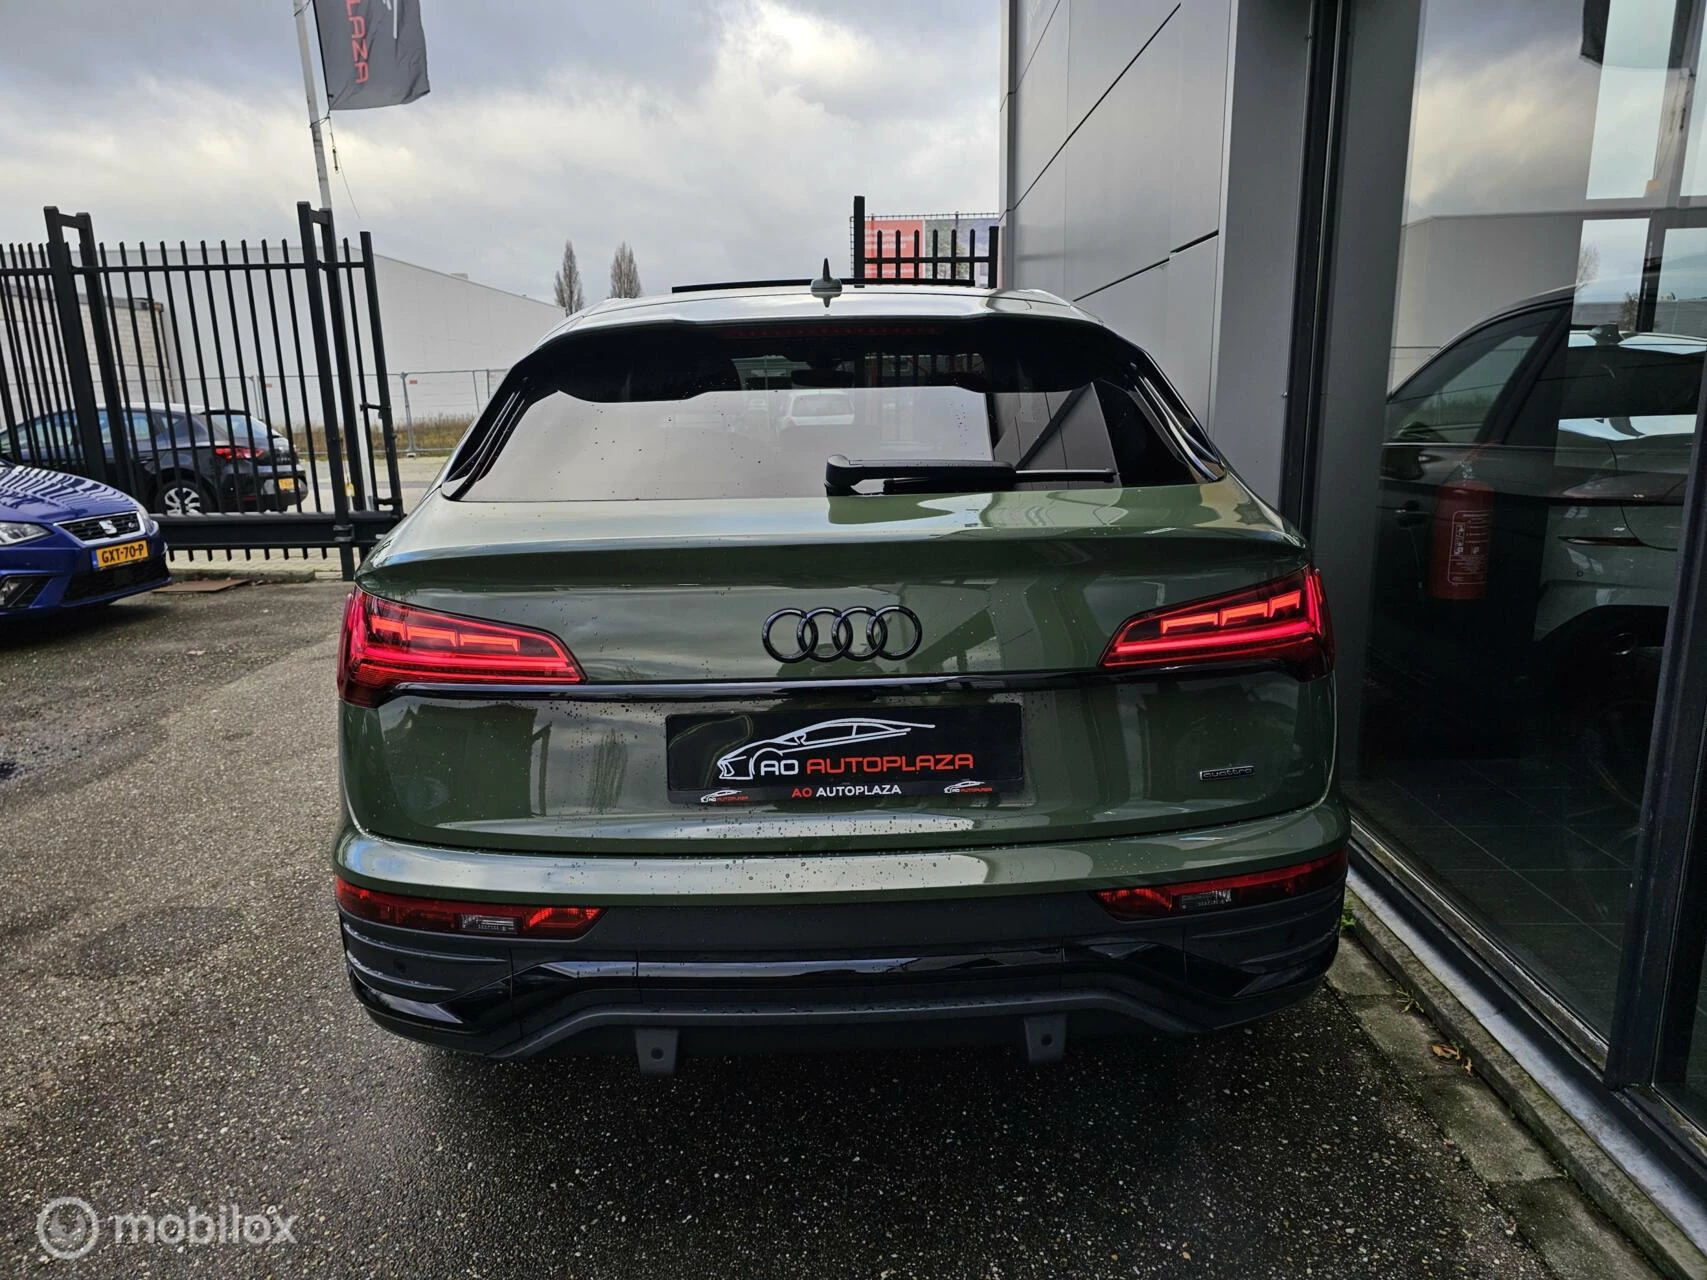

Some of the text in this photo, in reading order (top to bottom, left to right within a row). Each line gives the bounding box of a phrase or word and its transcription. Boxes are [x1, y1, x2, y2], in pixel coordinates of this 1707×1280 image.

[102, 543, 144, 563] GXT-70-P
[760, 753, 974, 776] AO AUTOPLAZA
[791, 784, 902, 798] AO AUTOPLAZA
